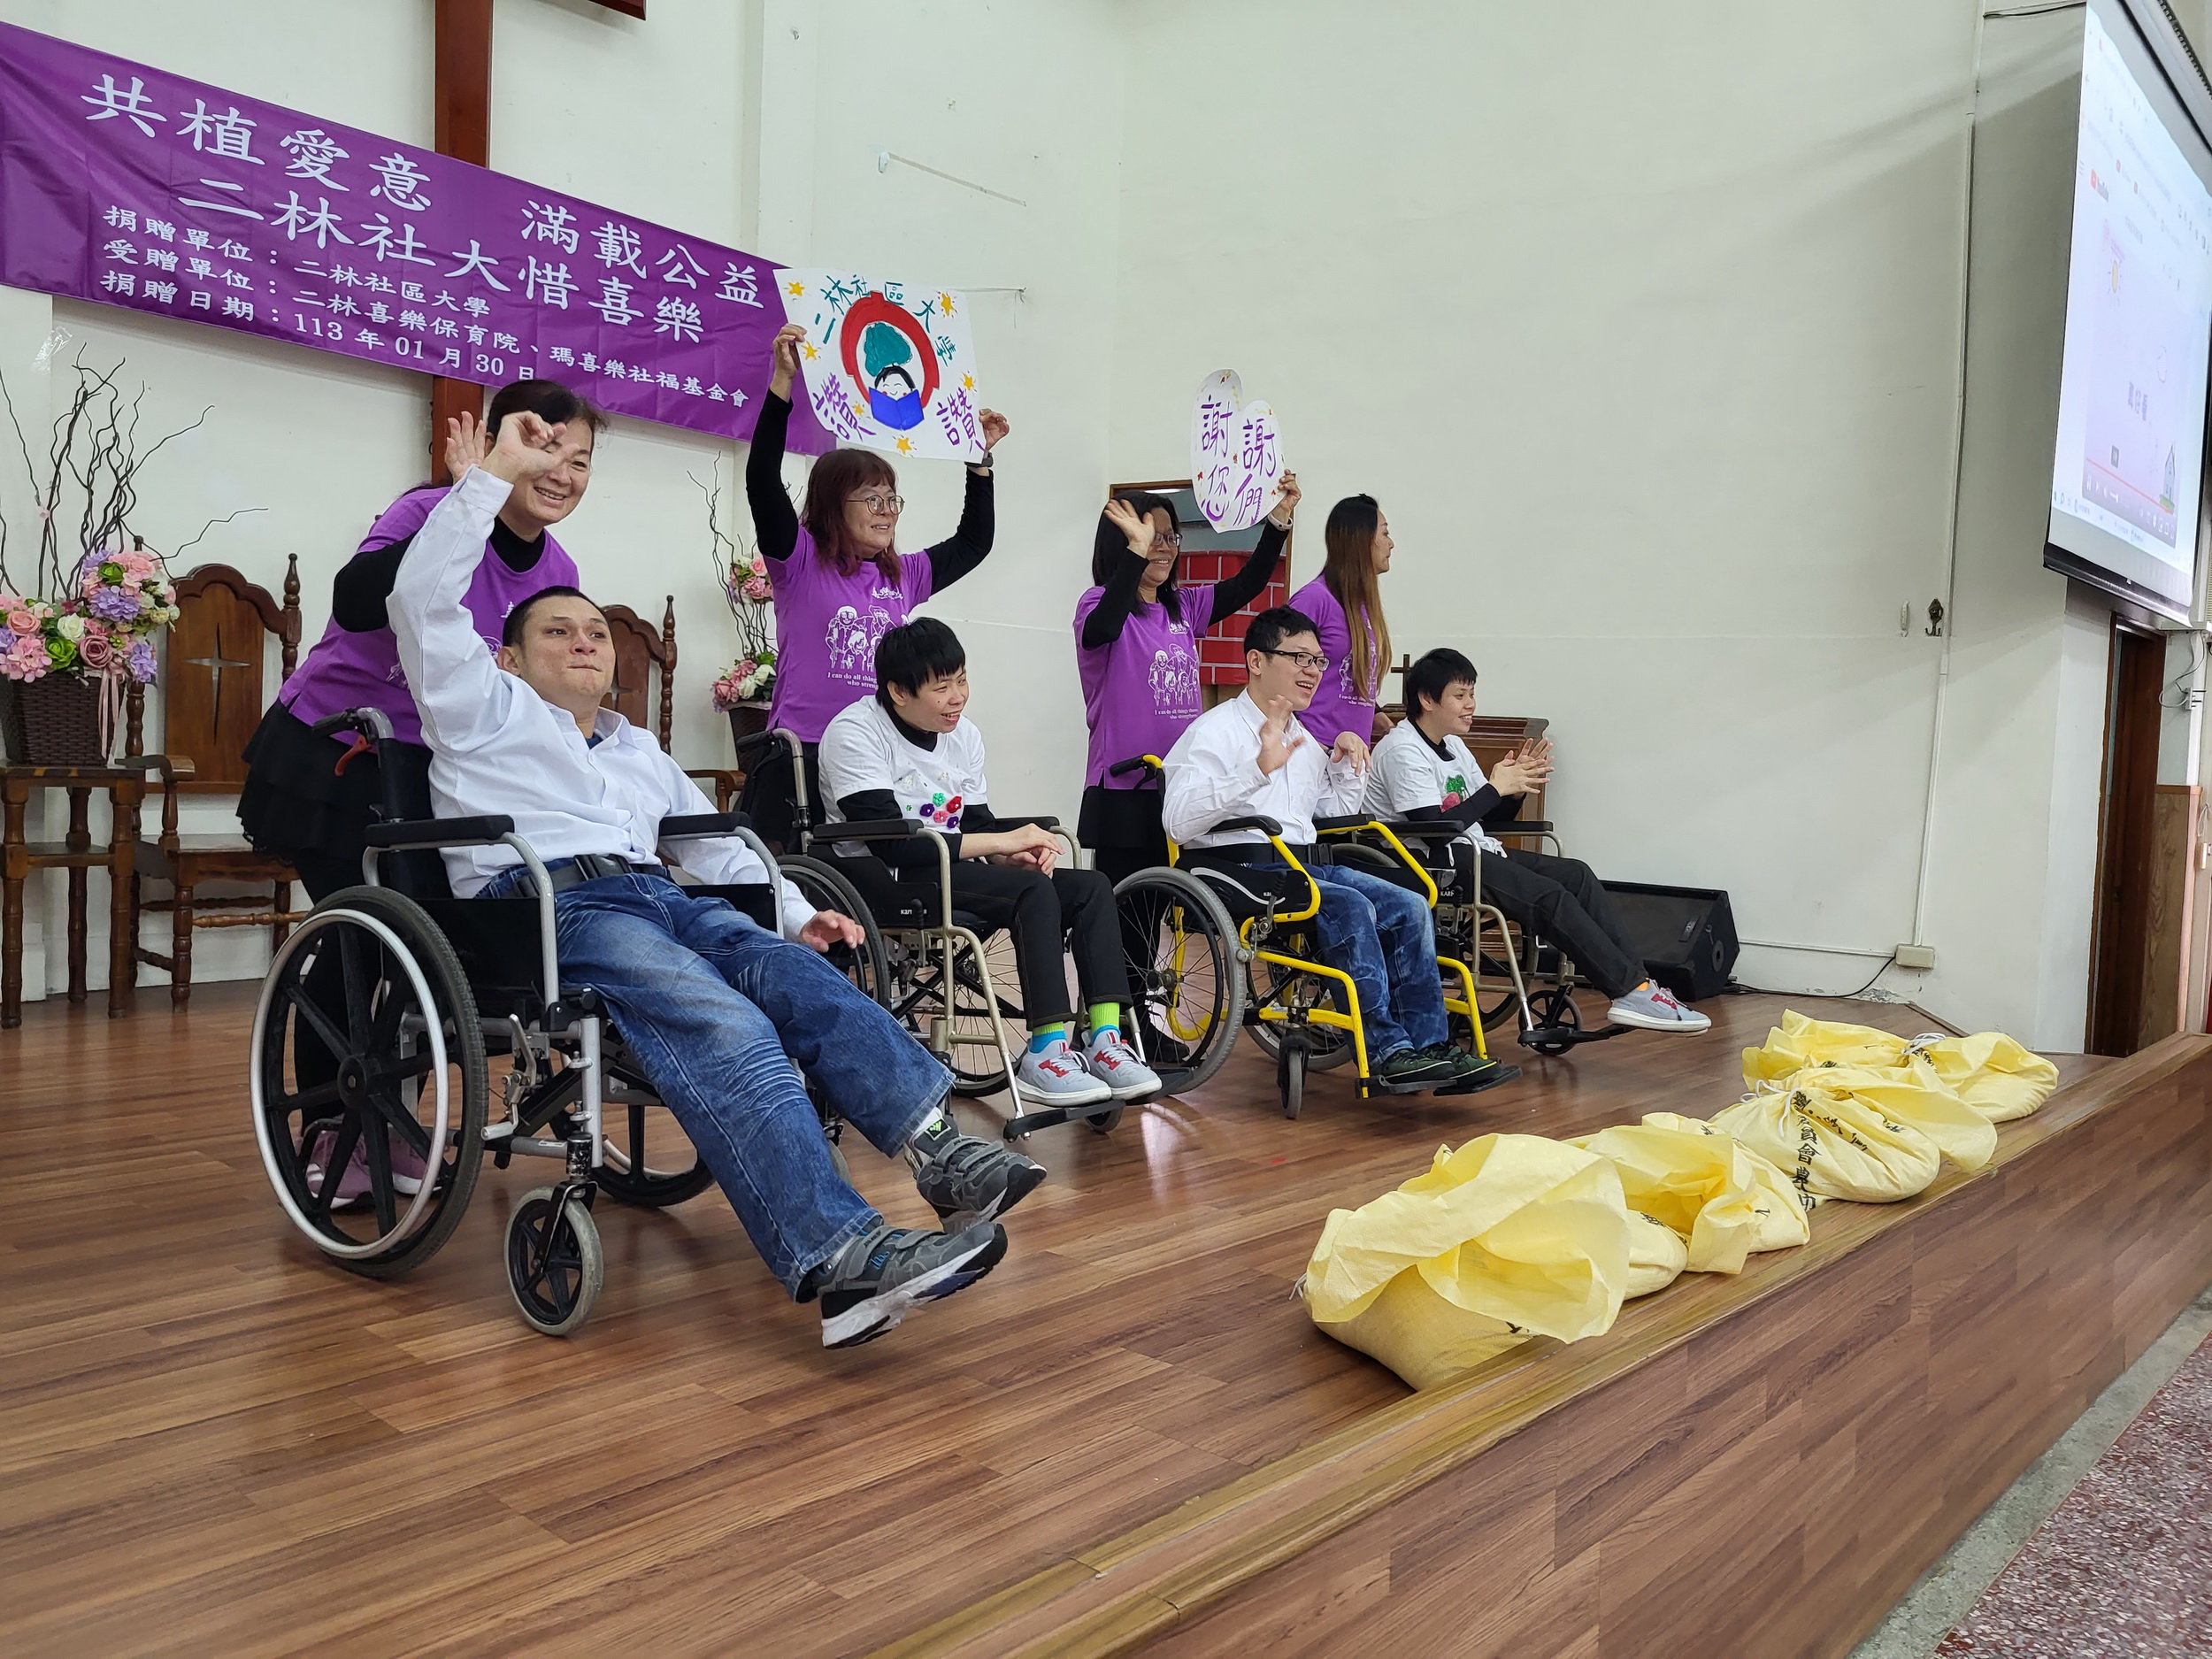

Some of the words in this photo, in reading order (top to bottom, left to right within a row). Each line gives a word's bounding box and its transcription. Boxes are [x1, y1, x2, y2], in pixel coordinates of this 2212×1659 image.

[80, 73, 434, 212] 共植愛意
[520, 199, 765, 309] 滿載公益
[177, 177, 706, 343] 二林社大惜喜樂
